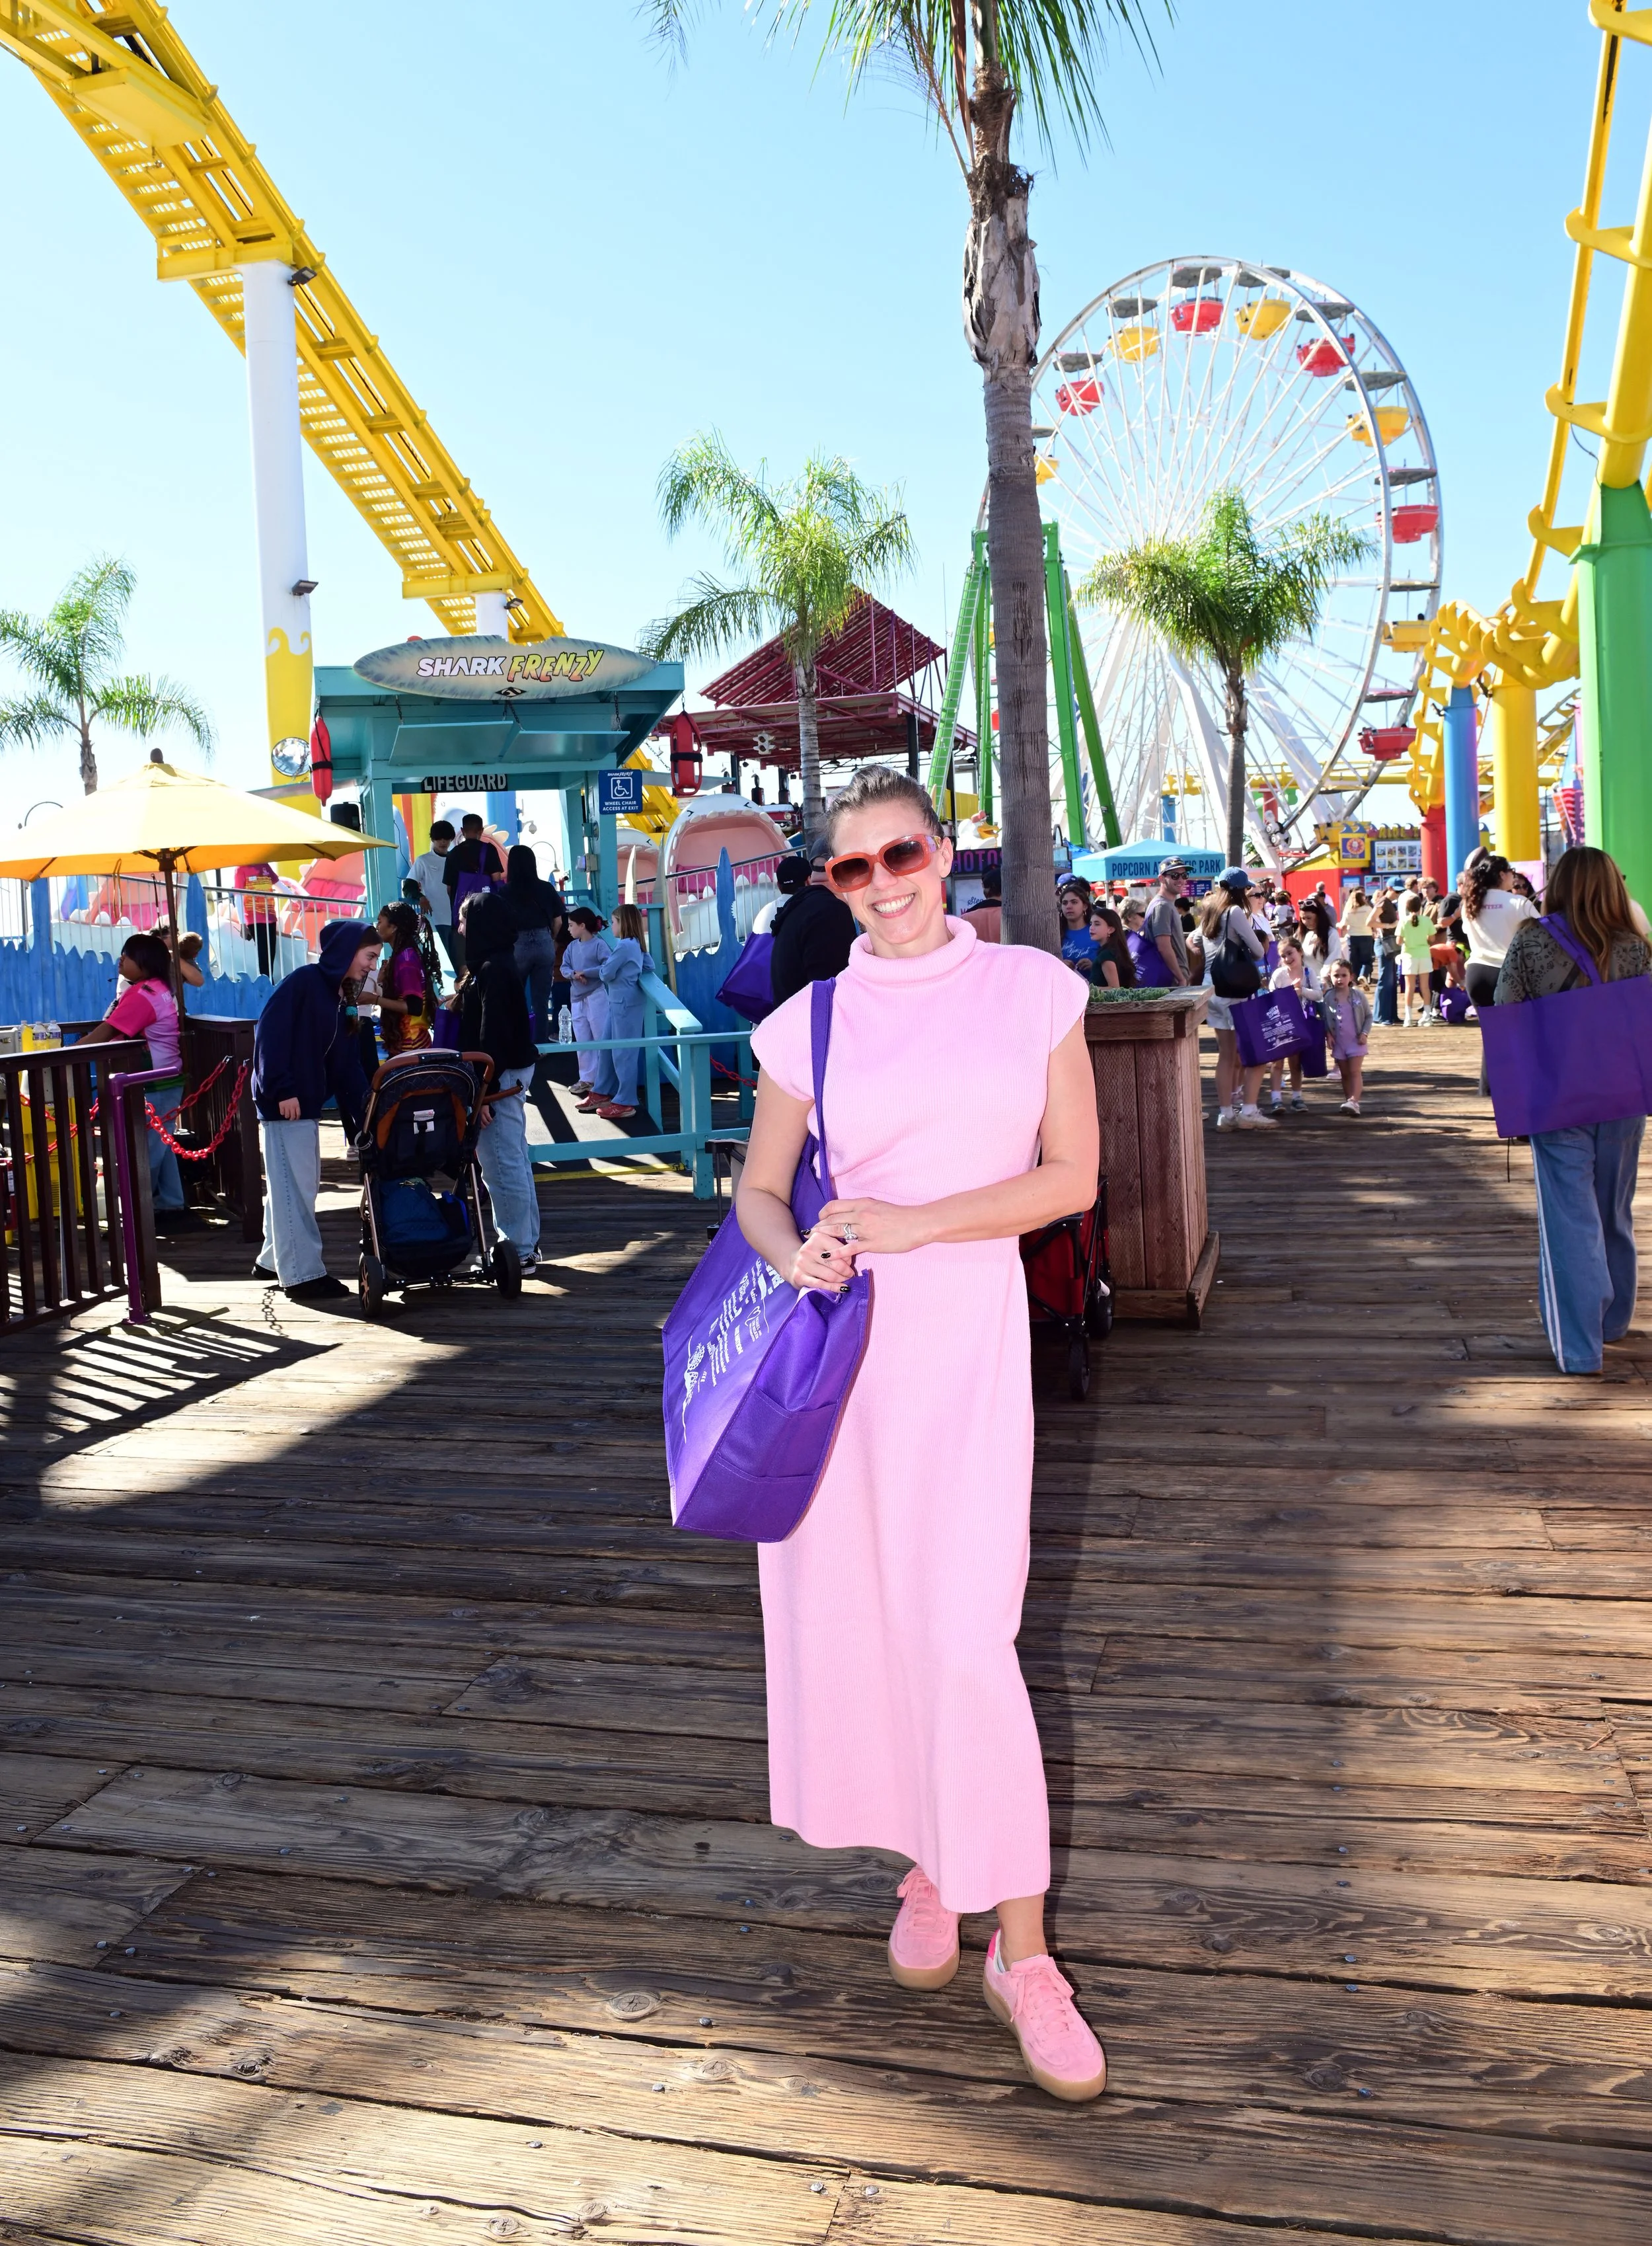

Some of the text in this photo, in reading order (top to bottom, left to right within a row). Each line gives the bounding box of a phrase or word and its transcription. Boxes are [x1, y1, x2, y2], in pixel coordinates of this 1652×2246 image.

[417, 650, 604, 682] SHARK FRENZY
[424, 773, 506, 791] LIFEGUARD
[1112, 862, 1150, 877] POPCORN
[1199, 860, 1221, 874] PARK
